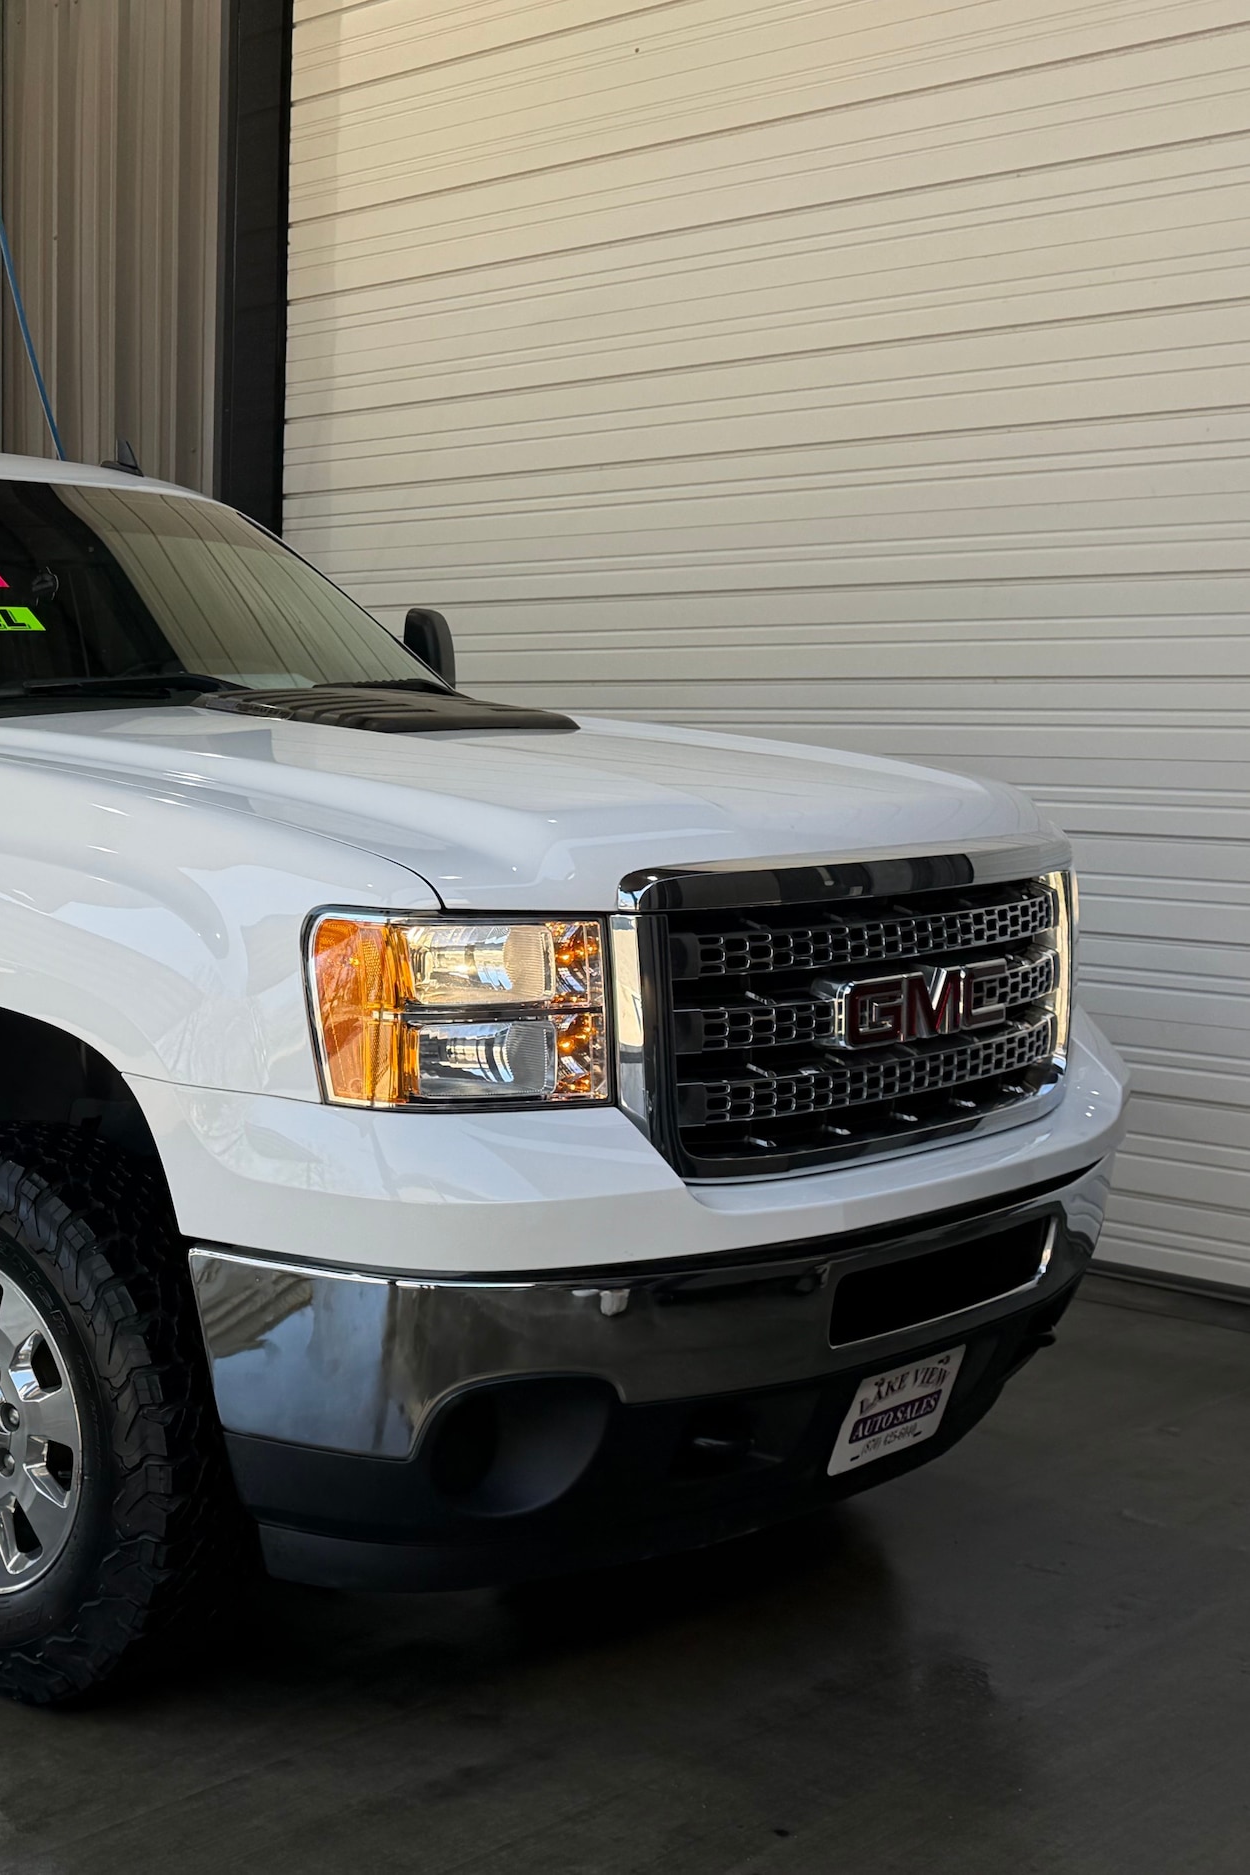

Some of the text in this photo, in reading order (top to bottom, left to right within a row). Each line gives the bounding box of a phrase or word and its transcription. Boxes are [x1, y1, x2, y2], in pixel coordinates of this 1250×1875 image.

[844, 957, 1007, 1050] GMC
[859, 1366, 951, 1416] LAKE VIEW
[852, 1393, 938, 1440] AUTO SALES
